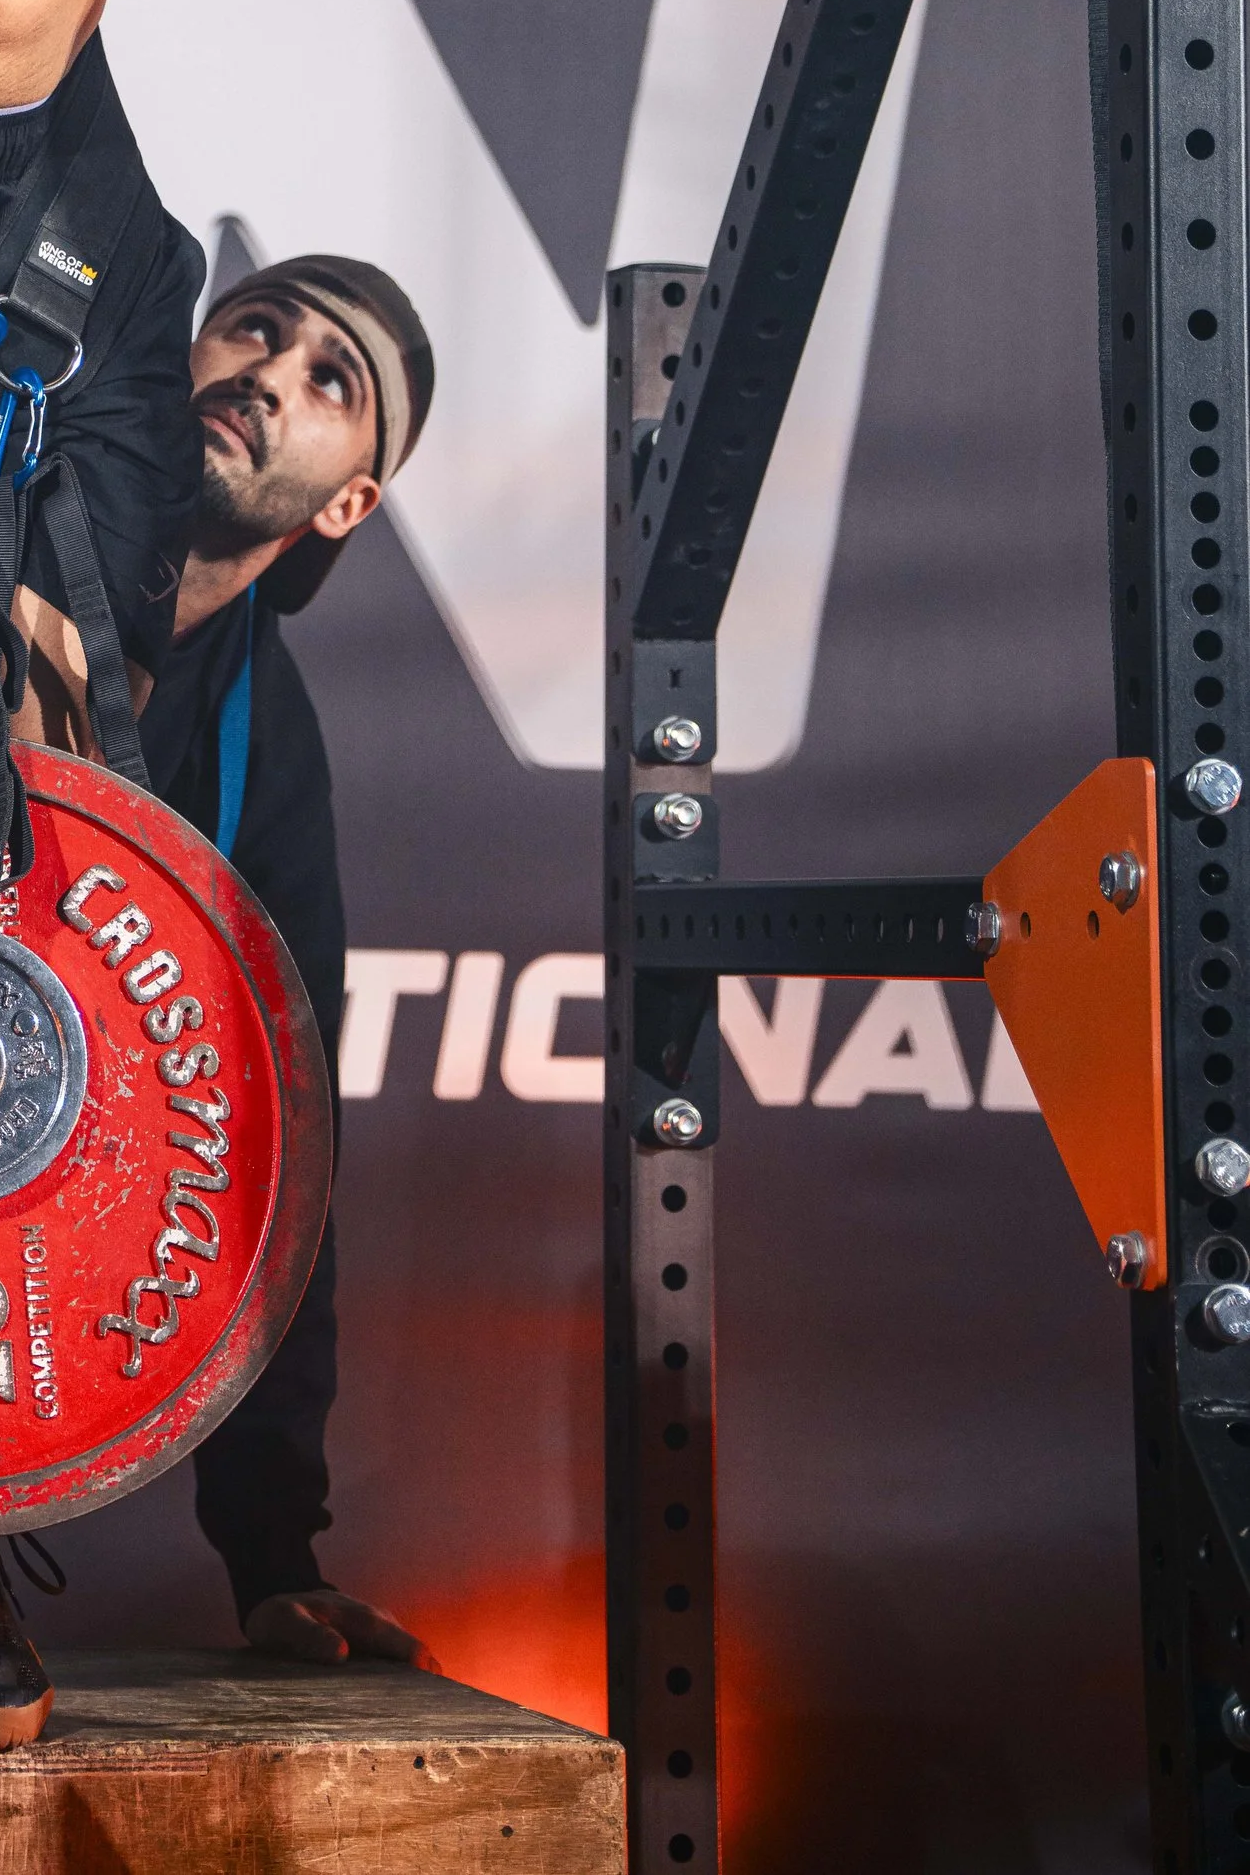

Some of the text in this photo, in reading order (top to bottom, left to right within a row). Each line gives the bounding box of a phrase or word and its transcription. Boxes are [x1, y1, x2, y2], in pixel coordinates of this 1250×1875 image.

[38, 247, 94, 286] WEIGHTED
[40, 241, 83, 269] KING OF
[20, 1224, 60, 1419] COMPETITION
